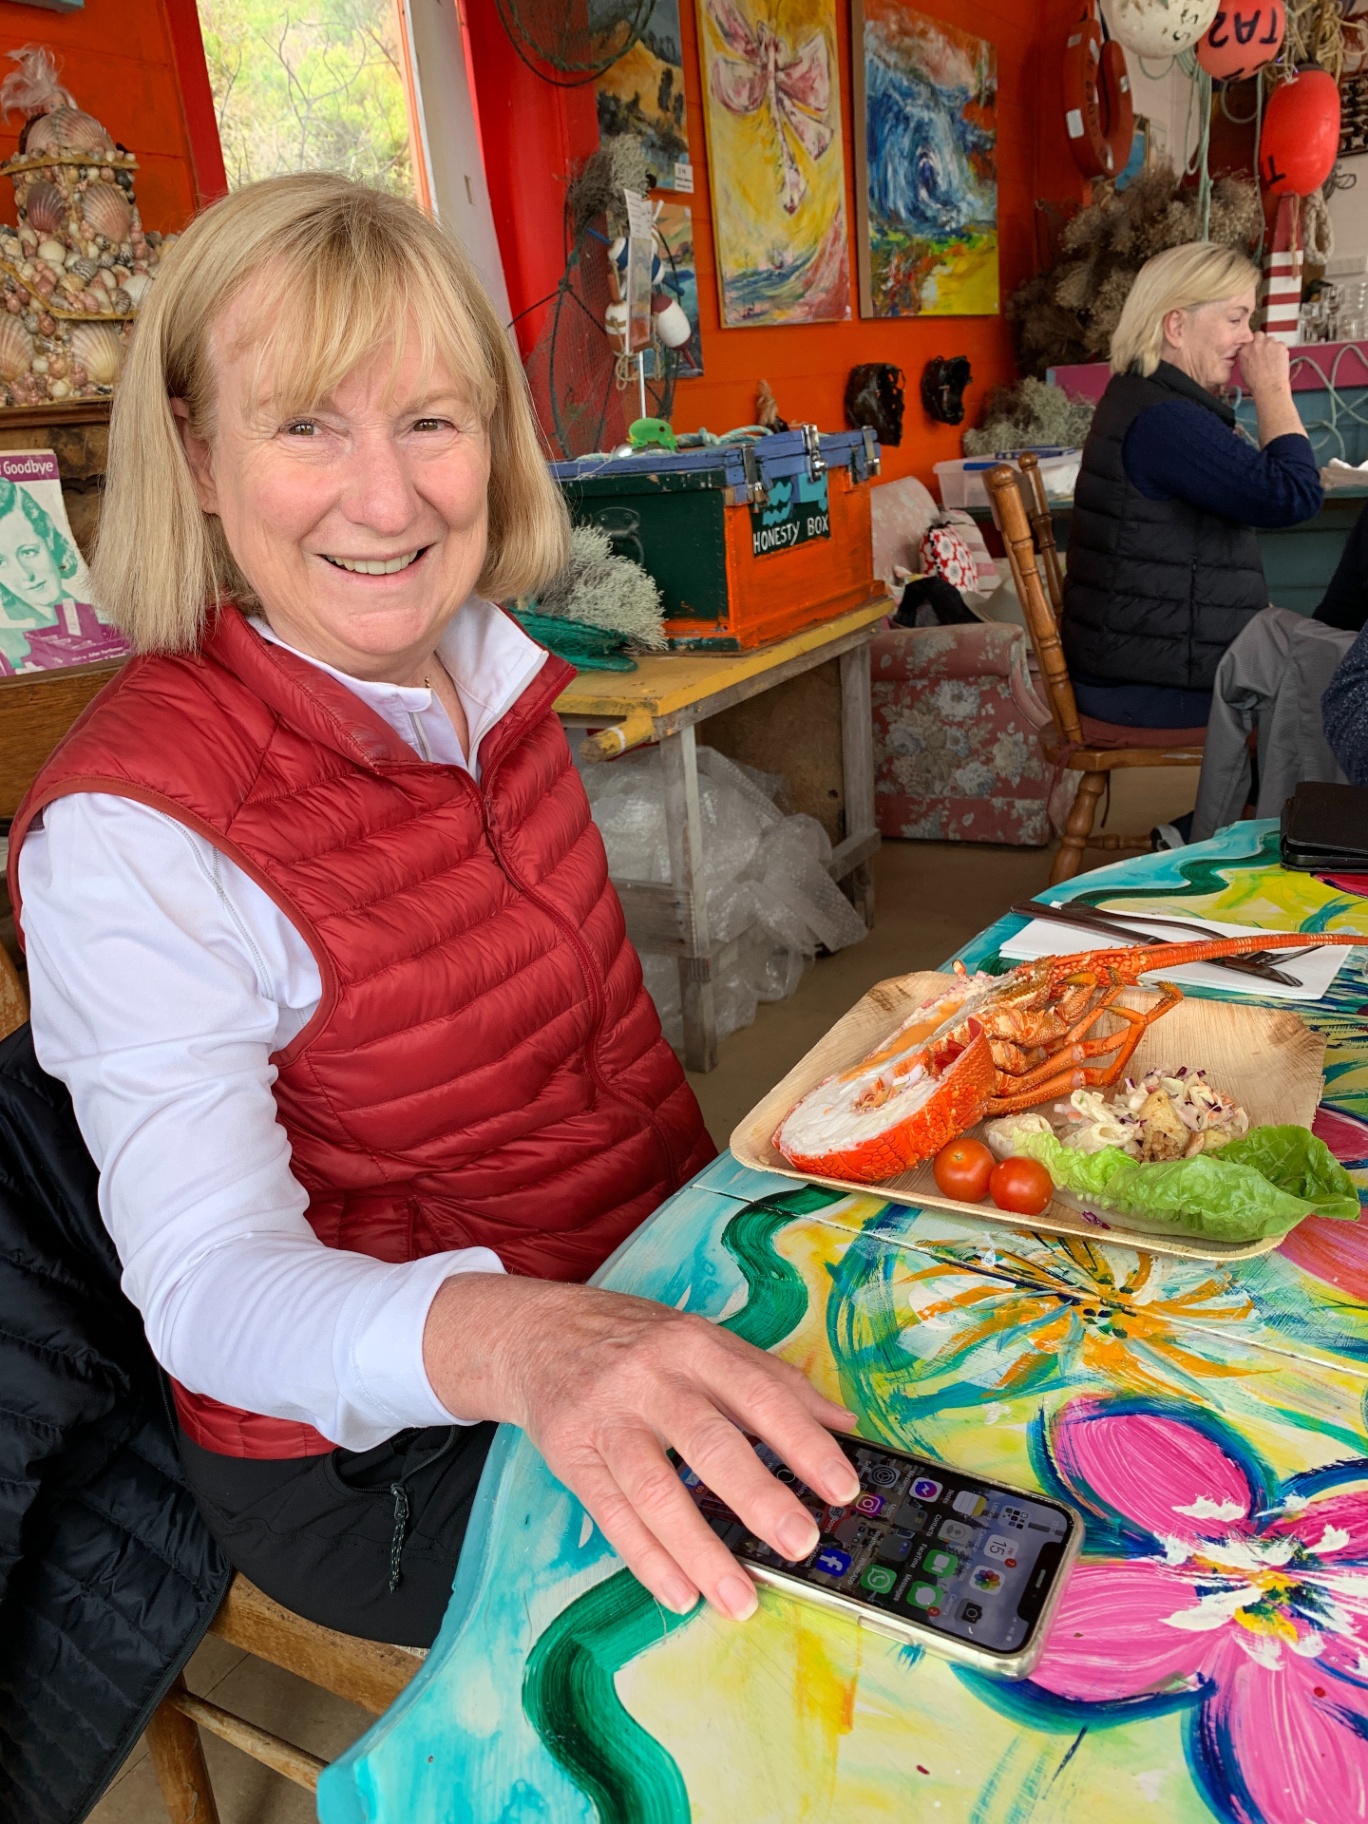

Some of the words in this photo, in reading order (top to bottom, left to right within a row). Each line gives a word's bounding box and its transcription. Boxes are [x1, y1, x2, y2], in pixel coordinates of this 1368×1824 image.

[1208, 7, 1278, 48] TA2
[3, 460, 54, 475] Goodbye
[753, 521, 800, 554] HONESTY
[807, 515, 829, 536] BOX
[942, 1489, 955, 1504] Notes
[925, 1514, 942, 1537] Contacts
[910, 1543, 927, 1569] FaceTime
[989, 1541, 1007, 1555] 15
[893, 1573, 912, 1601] Messages
